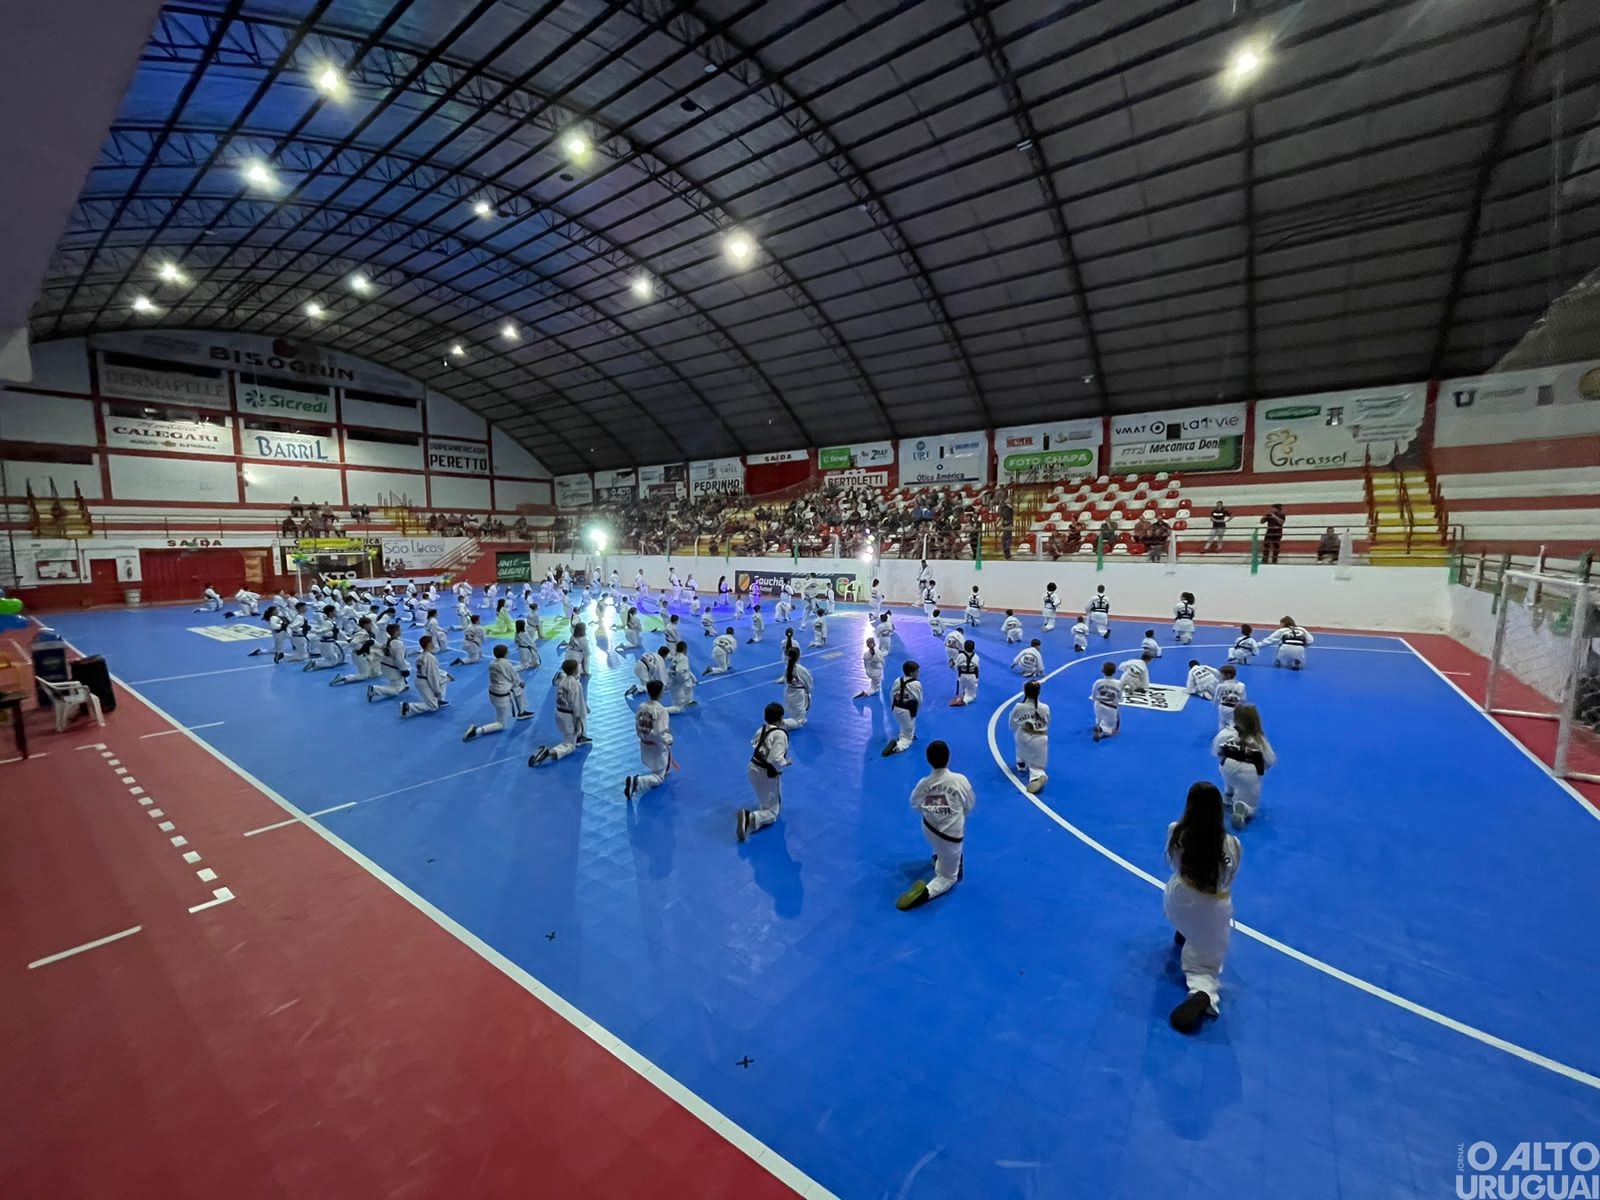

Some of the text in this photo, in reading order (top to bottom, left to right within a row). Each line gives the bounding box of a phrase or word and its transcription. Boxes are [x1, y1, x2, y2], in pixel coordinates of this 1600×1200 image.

[268, 394, 328, 414] Sicredi
[112, 426, 220, 443] CALEGARI
[430, 454, 488, 471] PERETTO
[1008, 457, 1041, 469] FOTO
[827, 474, 884, 491] BERTOLETTI
[167, 539, 223, 547] SADA
